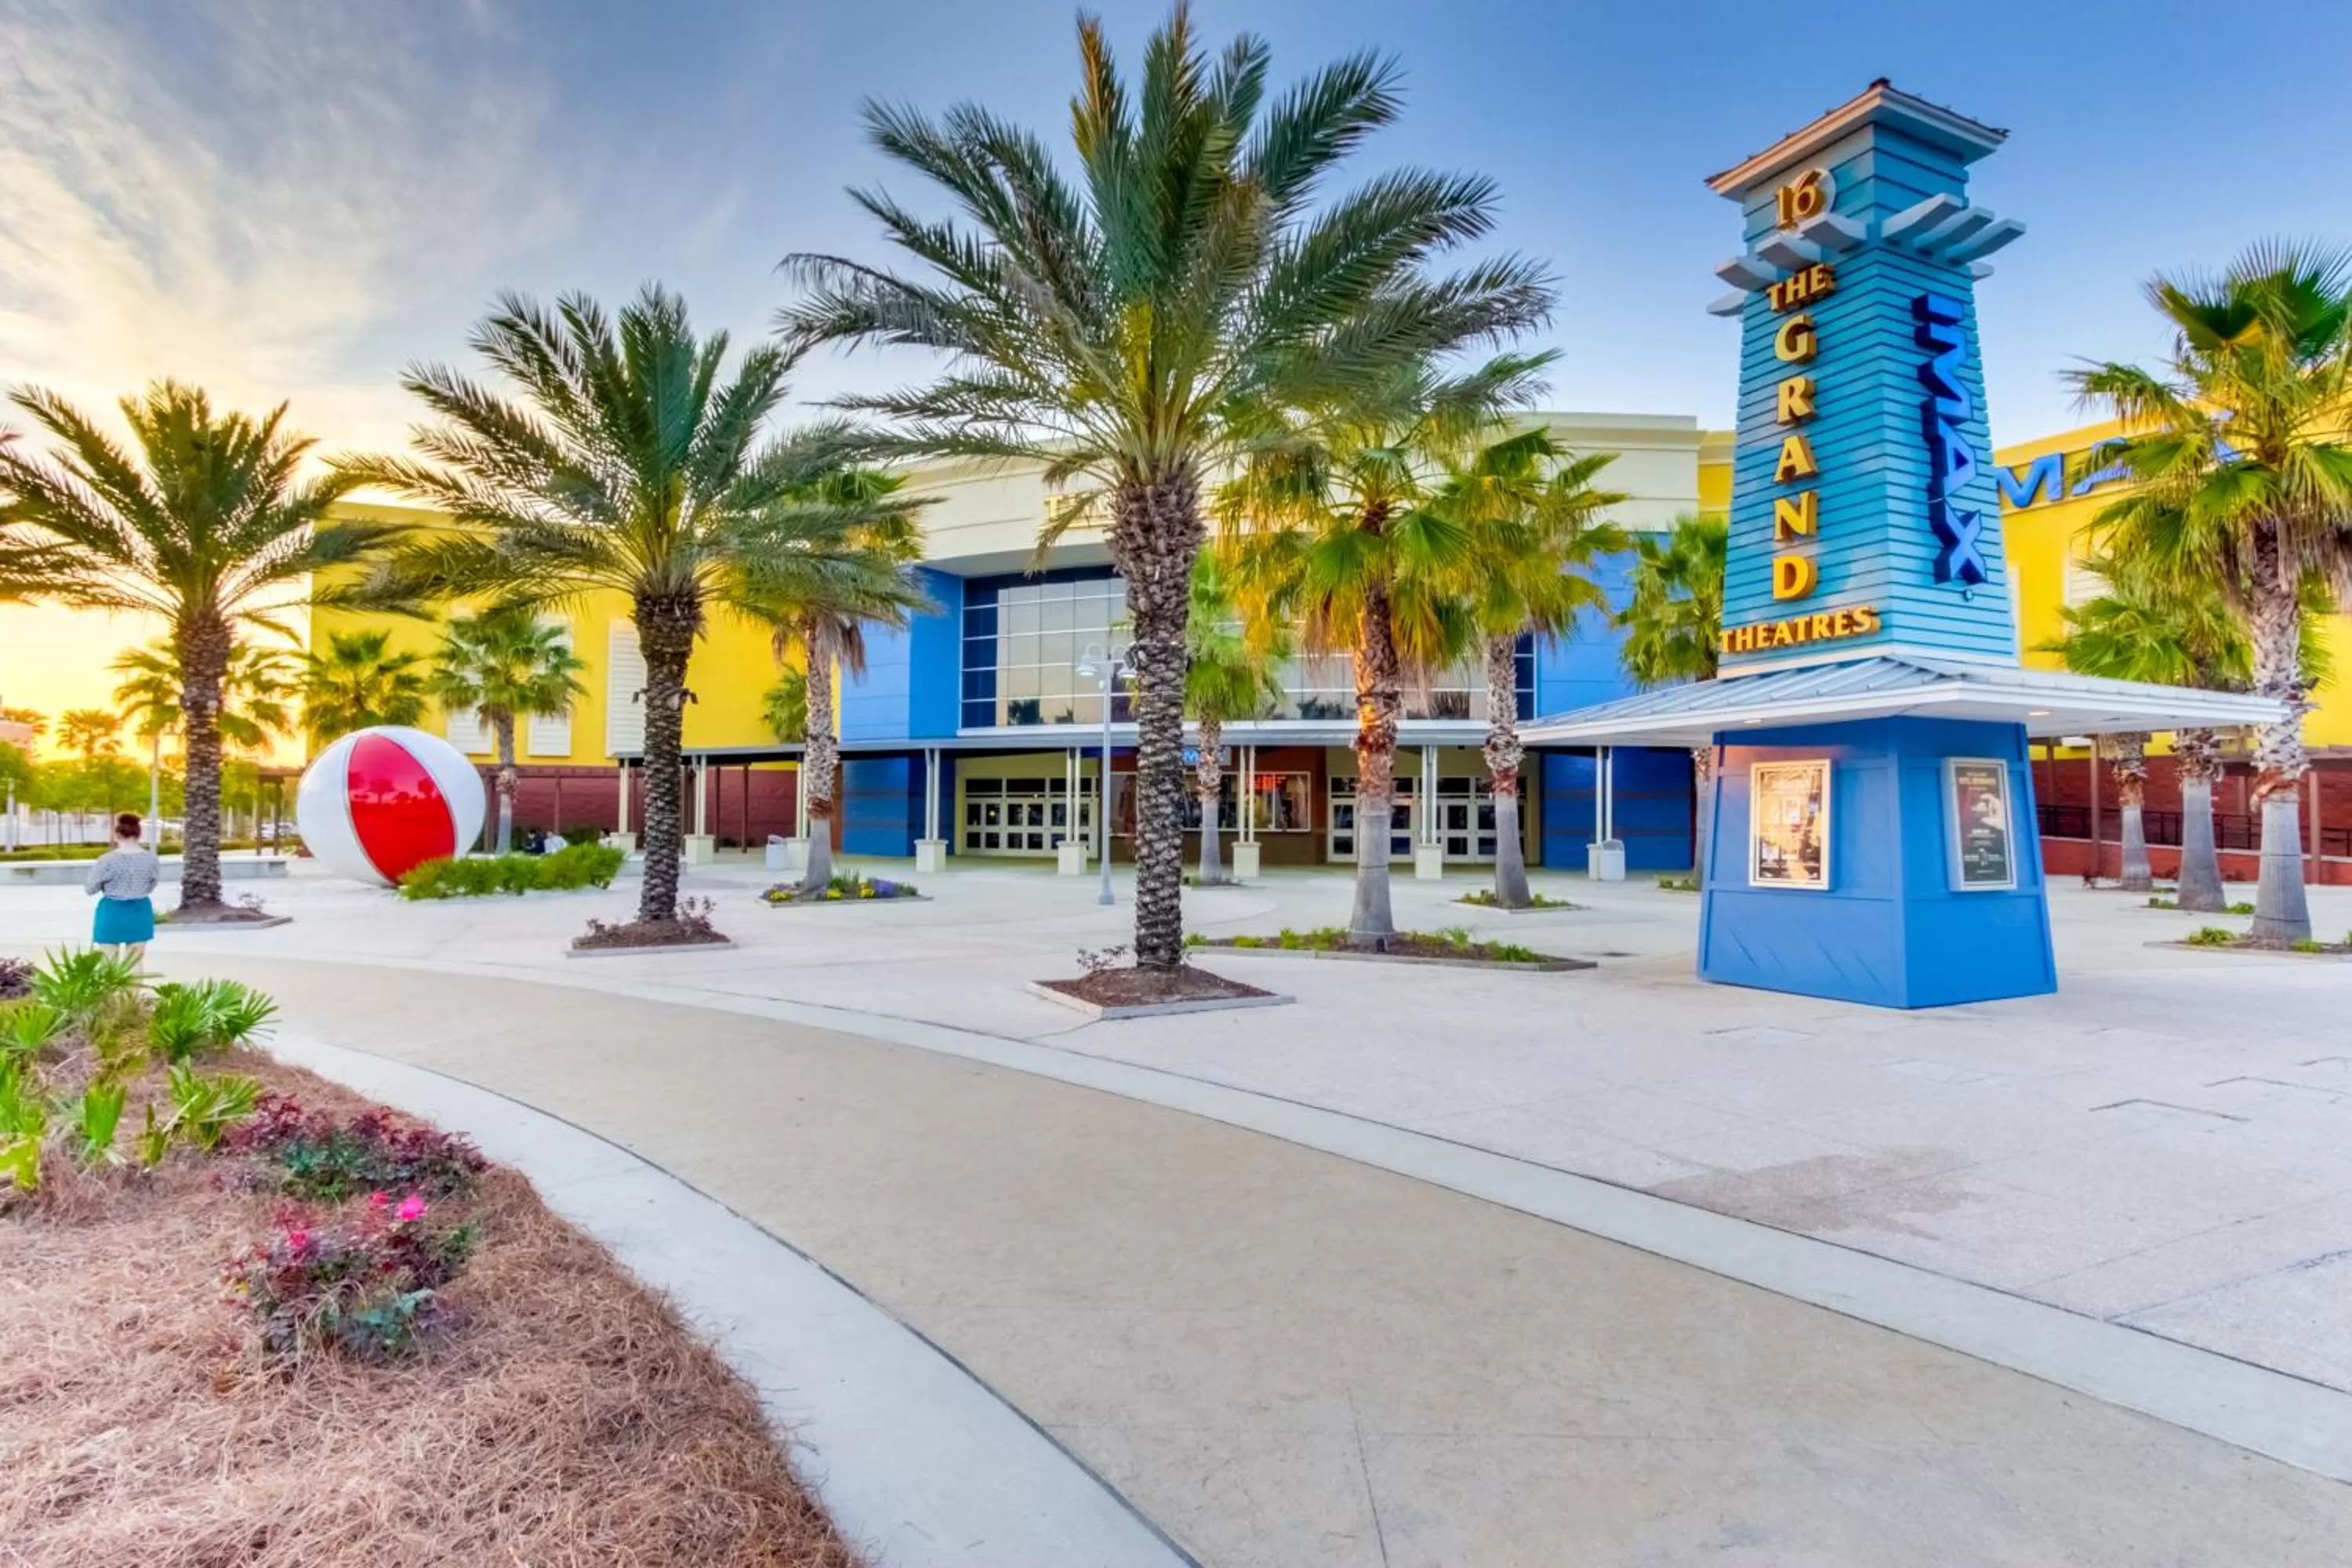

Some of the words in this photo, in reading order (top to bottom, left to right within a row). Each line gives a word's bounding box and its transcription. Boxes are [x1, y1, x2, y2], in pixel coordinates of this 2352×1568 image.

[1776, 169, 1825, 229] 16
[1767, 263, 1832, 312] THE
[1773, 314, 1817, 601] GRAND
[1913, 293, 1987, 585] IMAX
[1719, 605, 1881, 653] THEATRES
